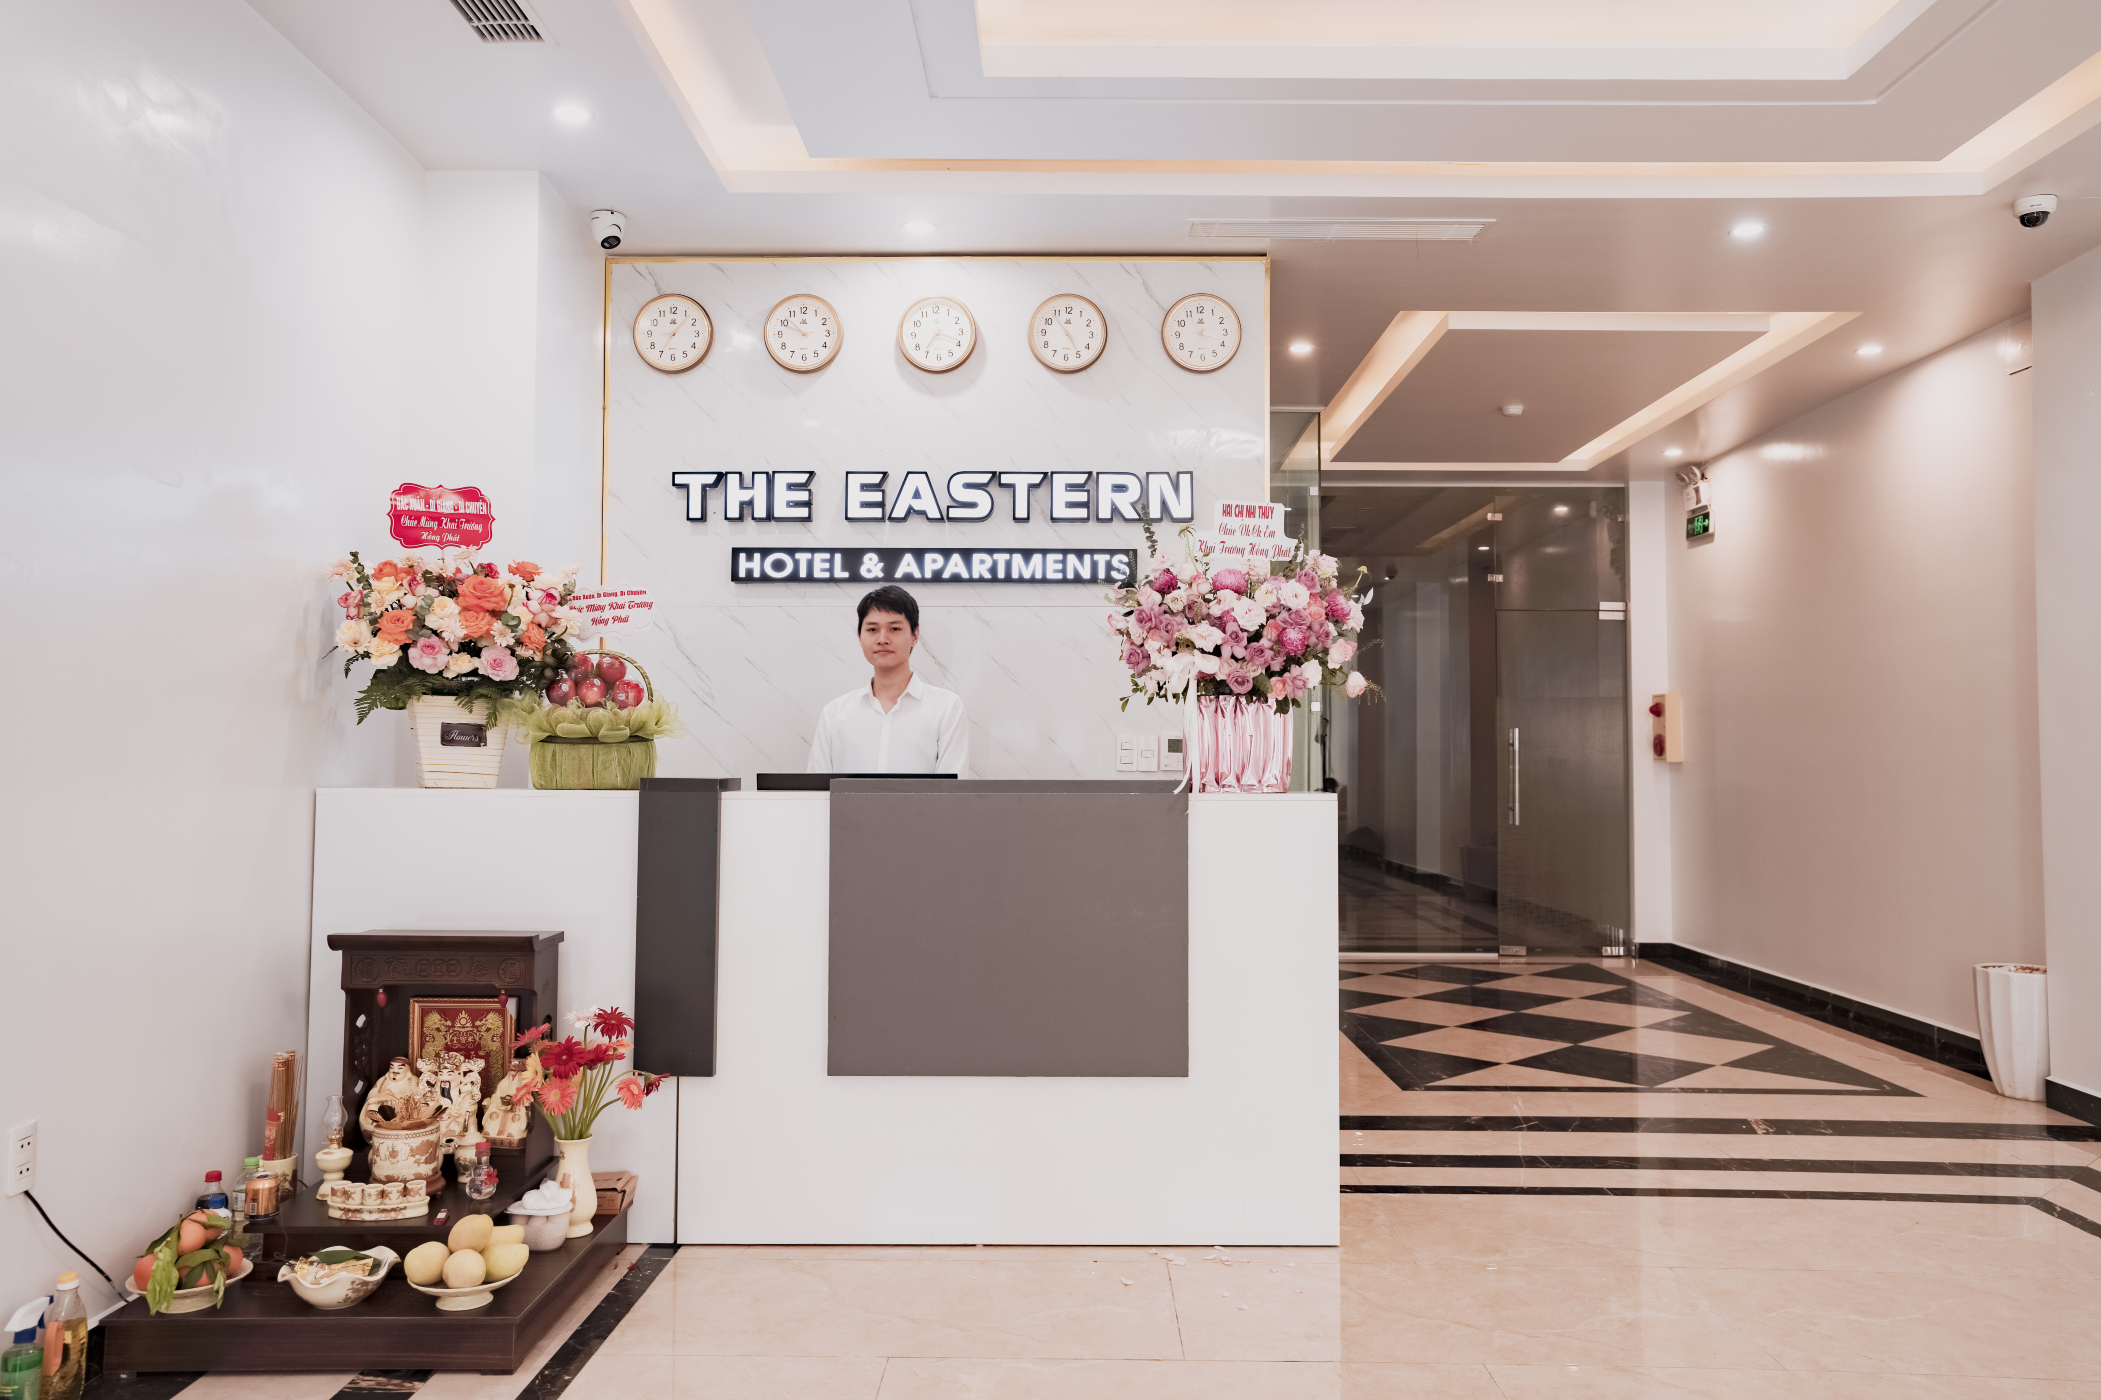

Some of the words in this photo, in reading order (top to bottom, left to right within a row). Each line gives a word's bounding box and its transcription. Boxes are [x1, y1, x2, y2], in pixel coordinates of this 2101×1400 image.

[659, 310, 665, 318] 11
[670, 306, 677, 314] 12
[789, 310, 795, 318] 11
[800, 306, 807, 314] 12
[932, 306, 939, 314] 12
[1054, 309, 1060, 317] 11
[1065, 306, 1073, 314] 12
[1186, 310, 1192, 318] 11
[1196, 306, 1204, 314] 12
[922, 311, 927, 319] 11
[650, 319, 658, 327] 10
[691, 318, 696, 326] 2
[781, 319, 788, 327] 10
[822, 318, 827, 326] 2
[914, 320, 921, 328] 10
[955, 317, 960, 325] 2
[1045, 318, 1052, 326] 10
[1086, 319, 1091, 327] 2
[1177, 319, 1185, 327] 10
[1219, 317, 1224, 325] 2
[647, 330, 652, 338] 9
[695, 330, 700, 338] 3
[778, 331, 783, 339] 9
[825, 329, 830, 337] 3
[911, 332, 916, 340] 9
[959, 328, 964, 336] 3
[1041, 329, 1046, 337] 9
[1089, 331, 1094, 339] 3
[1175, 331, 1180, 339] 9
[1223, 329, 1228, 337] 3
[650, 342, 655, 350] 8
[691, 342, 696, 350] 4
[781, 342, 786, 350] 8
[822, 341, 827, 349] 4
[915, 343, 920, 351] 8
[1044, 341, 1049, 349] 8
[1085, 343, 1090, 351] 4
[1179, 343, 1184, 351] 8
[1220, 341, 1225, 349] 4
[659, 351, 664, 359] 7
[670, 354, 675, 362] 6
[682, 351, 687, 359] 5
[790, 351, 795, 359] 7
[802, 354, 807, 362] 6
[814, 350, 819, 358] 5
[925, 351, 930, 359] 7
[937, 354, 942, 362] 6
[948, 350, 953, 358] 5
[1052, 350, 1057, 358] 7
[1064, 354, 1069, 362] 6
[1076, 351, 1081, 359] 5
[1188, 351, 1193, 359] 7
[1200, 354, 1205, 362] 6
[1212, 350, 1217, 358] 5
[671, 471, 816, 522] THE
[845, 471, 1194, 523] EASTERN
[1222, 503, 1232, 517] HAI
[1234, 504, 1244, 521] CHỊ
[1245, 505, 1256, 518] NHI
[401, 515, 418, 527] Chúc
[440, 517, 458, 530] Khai
[442, 532, 460, 542] Phát
[1197, 539, 1217, 554] Khai
[1271, 543, 1292, 560] Phát
[738, 552, 850, 580] HOTEL
[859, 552, 885, 579] &
[893, 553, 1131, 581] APARTMENTS
[608, 601, 626, 611] Khai
